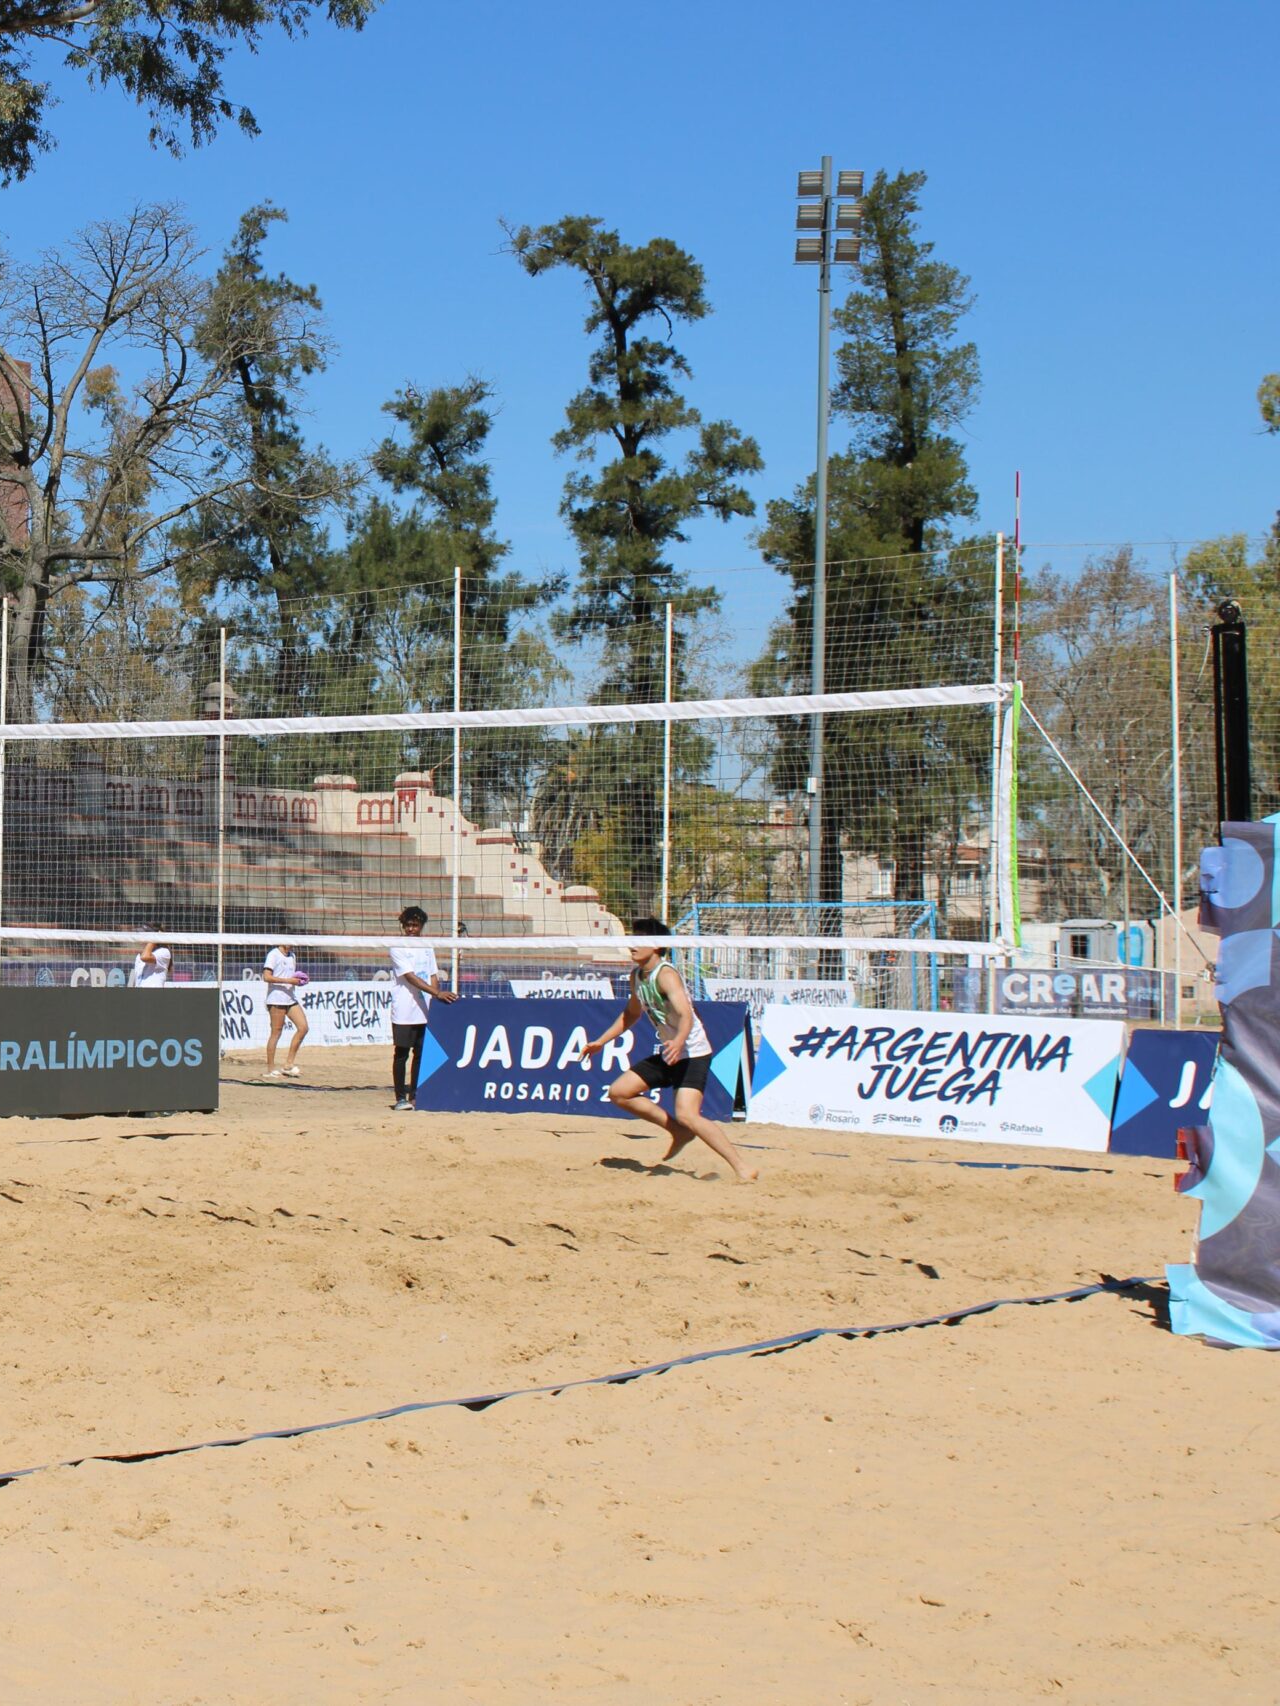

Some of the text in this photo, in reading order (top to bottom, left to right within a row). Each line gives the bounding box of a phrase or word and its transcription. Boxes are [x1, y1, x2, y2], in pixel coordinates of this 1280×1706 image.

[333, 1010, 382, 1030] JUEGA
[456, 1024, 634, 1072] JADAR
[788, 1025, 1072, 1073] #ARGENTINA
[483, 1082, 590, 1101] ROSARIO
[857, 1064, 1002, 1106] JUEGA
[825, 1113, 860, 1125] Rosario
[888, 1113, 912, 1123] Santa
[1010, 1123, 1044, 1133] Rafaela
